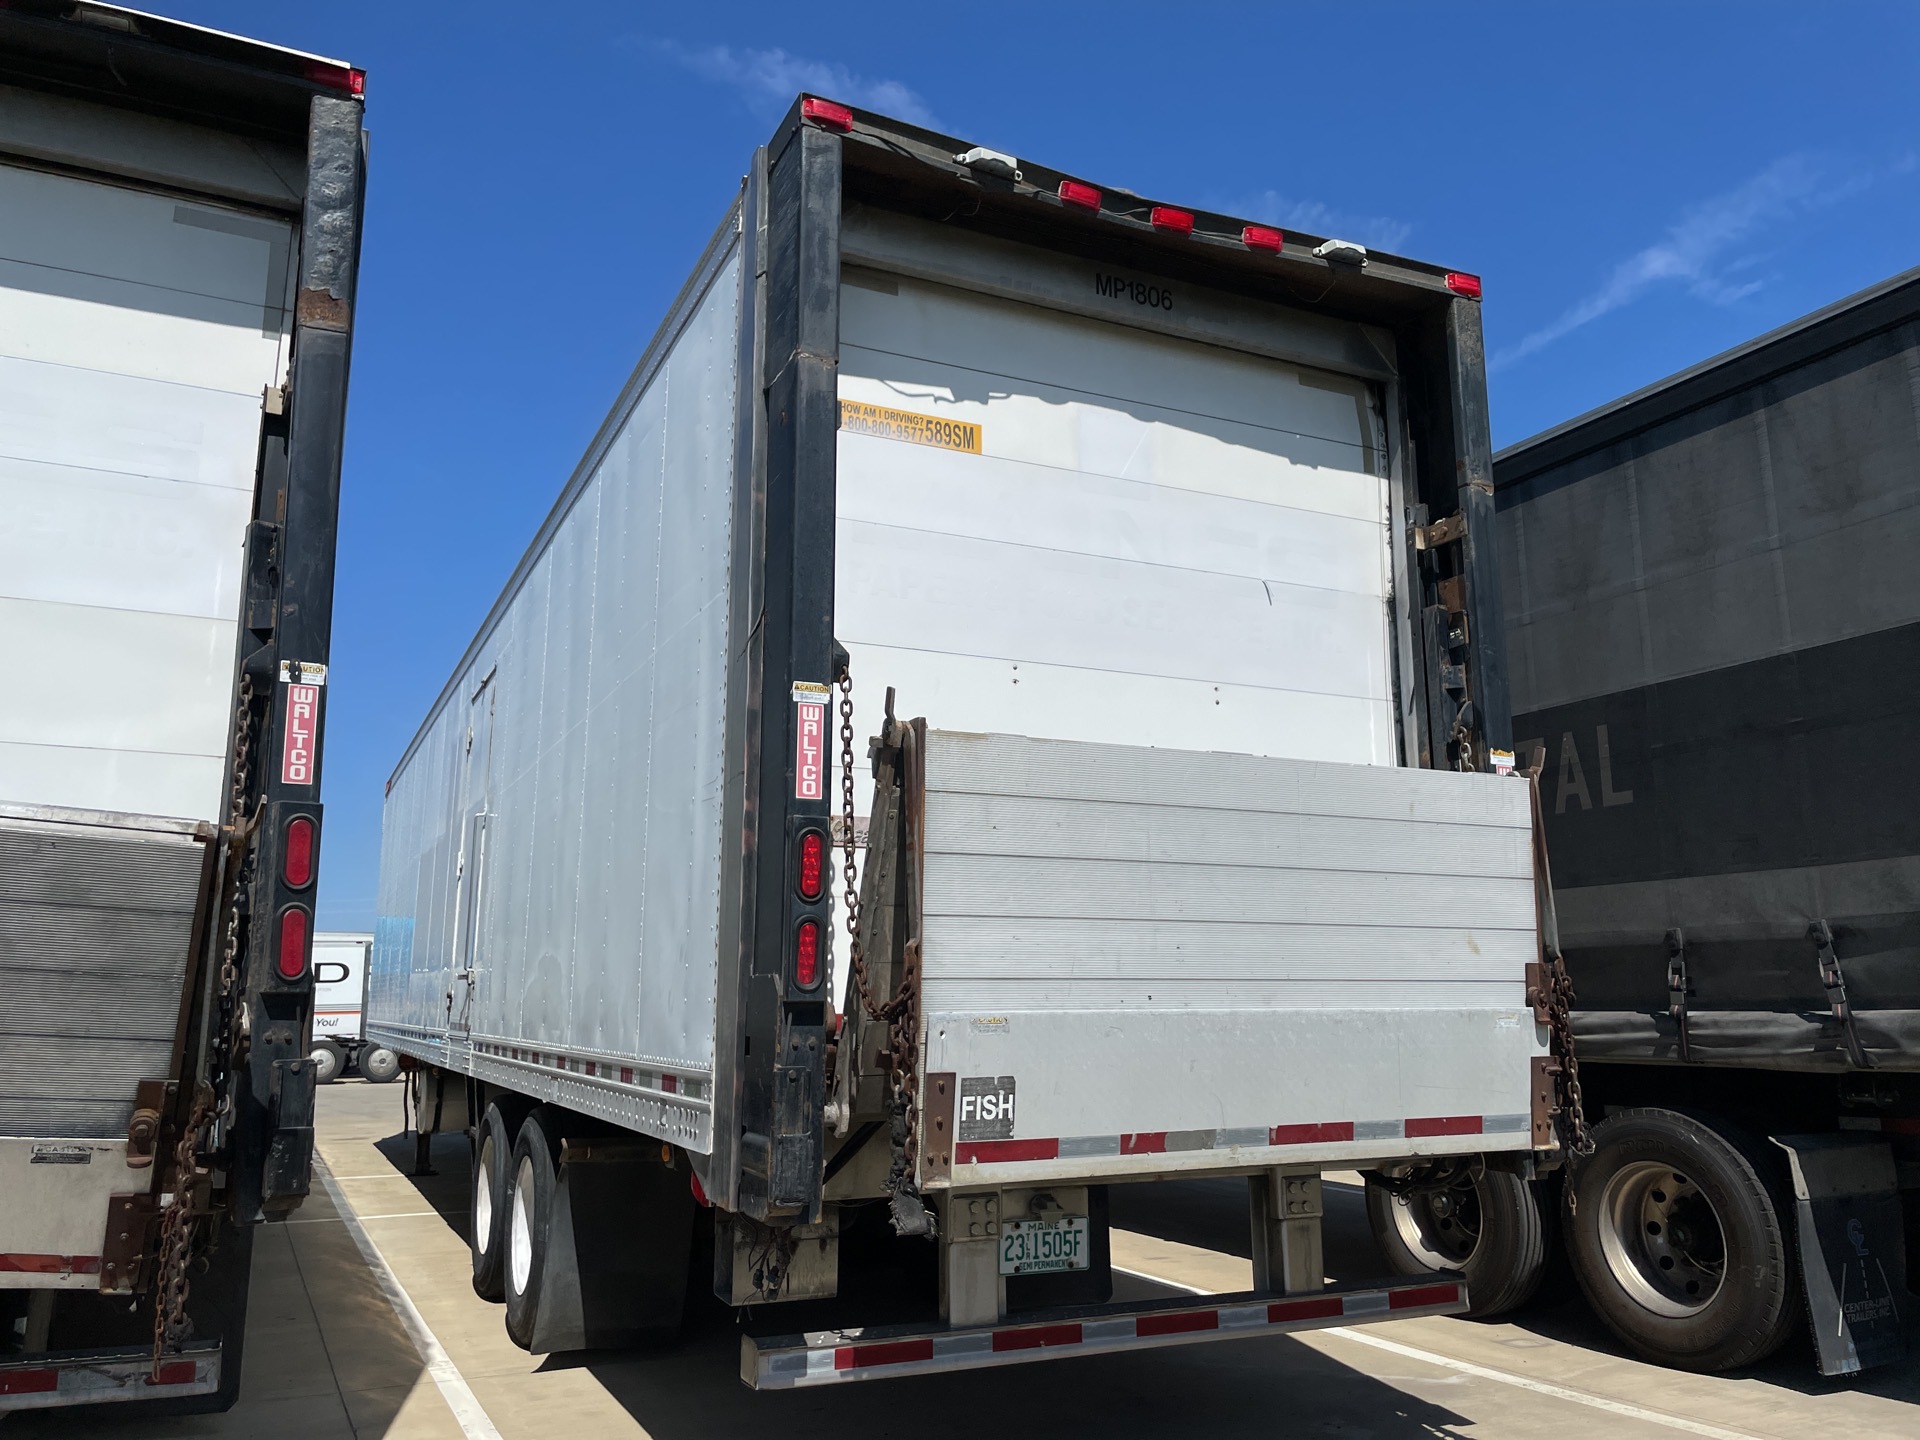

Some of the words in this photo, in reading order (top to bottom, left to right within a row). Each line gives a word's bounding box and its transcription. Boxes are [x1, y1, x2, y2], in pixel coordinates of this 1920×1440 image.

[1095, 273, 1173, 311] MP1806
[842, 414, 924, 442] -800-800-9577
[863, 406, 877, 418] AM
[884, 411, 924, 427] DRIVING?
[925, 419, 975, 450] 589SM
[799, 684, 829, 693] CAUTION
[289, 687, 314, 781] WALTCO
[802, 706, 820, 796] WALTCO
[316, 1018, 339, 1027] You!
[961, 1094, 1014, 1121] FISH
[1027, 1221, 1060, 1232] MAINE
